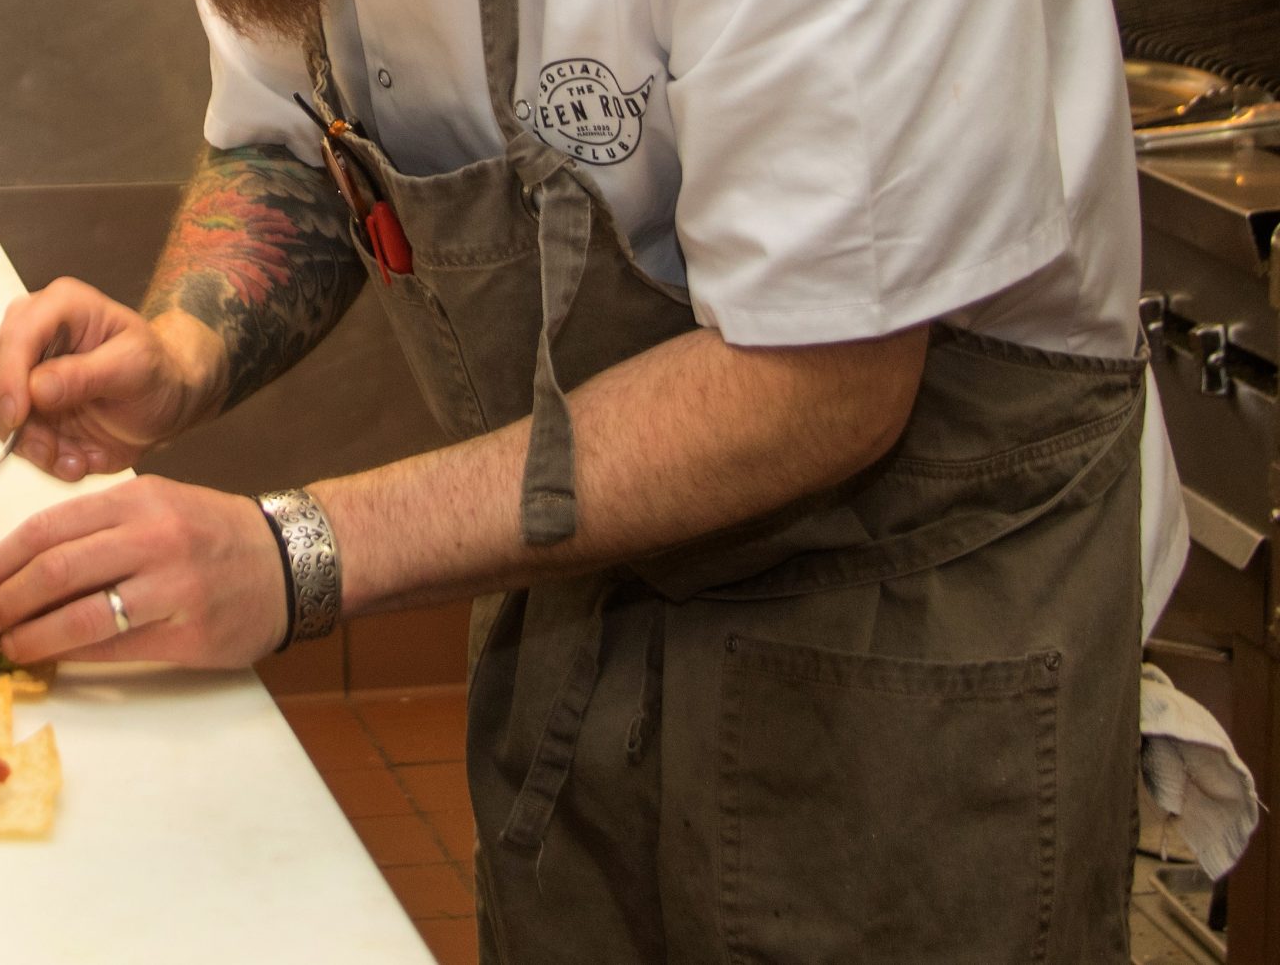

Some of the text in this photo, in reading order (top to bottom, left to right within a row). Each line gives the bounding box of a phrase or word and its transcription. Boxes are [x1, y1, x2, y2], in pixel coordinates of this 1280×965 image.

[540, 64, 602, 92] SOCIAL
[567, 84, 595, 97] THE
[574, 141, 629, 161] CLUB
